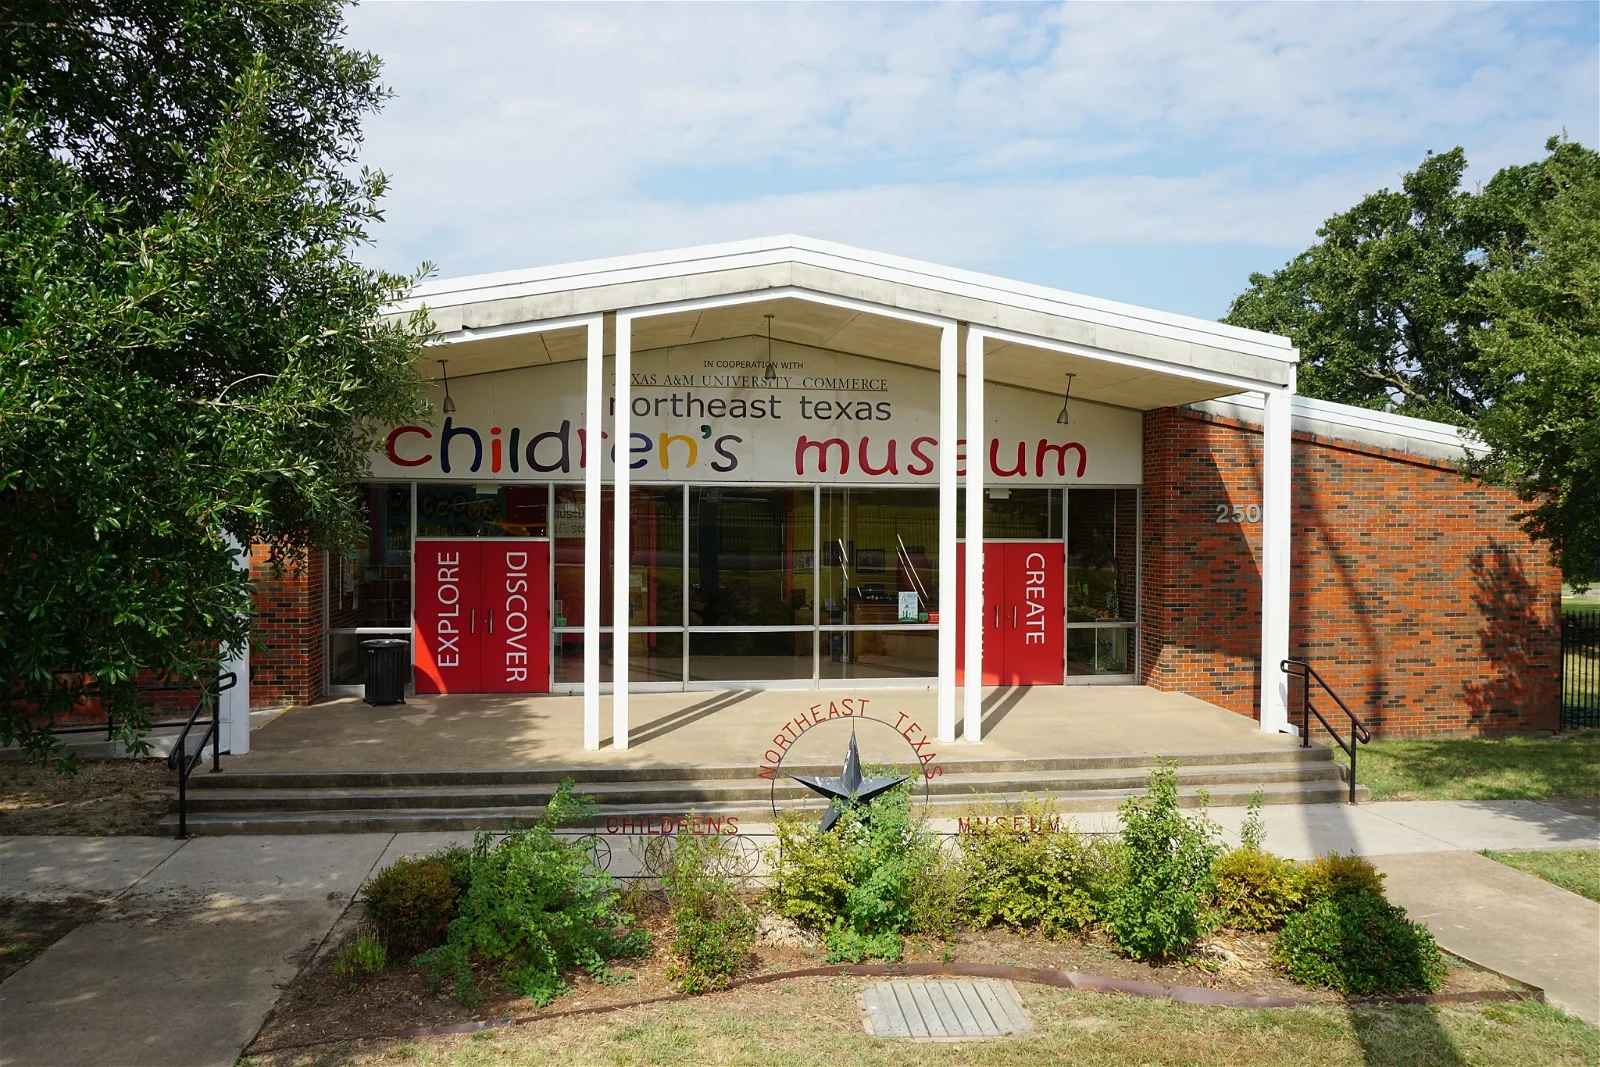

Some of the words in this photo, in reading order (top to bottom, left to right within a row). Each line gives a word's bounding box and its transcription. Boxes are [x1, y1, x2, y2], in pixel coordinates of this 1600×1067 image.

[610, 372, 657, 385] XAS
[663, 374, 694, 386] A&M
[703, 360, 714, 368] IN
[780, 361, 804, 370] WITH
[799, 395, 892, 422] texas
[795, 435, 1087, 478] musum
[437, 551, 460, 667] EXPLORE
[506, 551, 528, 683] DISCOVER
[1025, 552, 1046, 645] CREATE
[756, 698, 870, 781] NORTHEAST
[893, 711, 943, 780] TEXAS
[605, 814, 739, 836] CHILDREN'S
